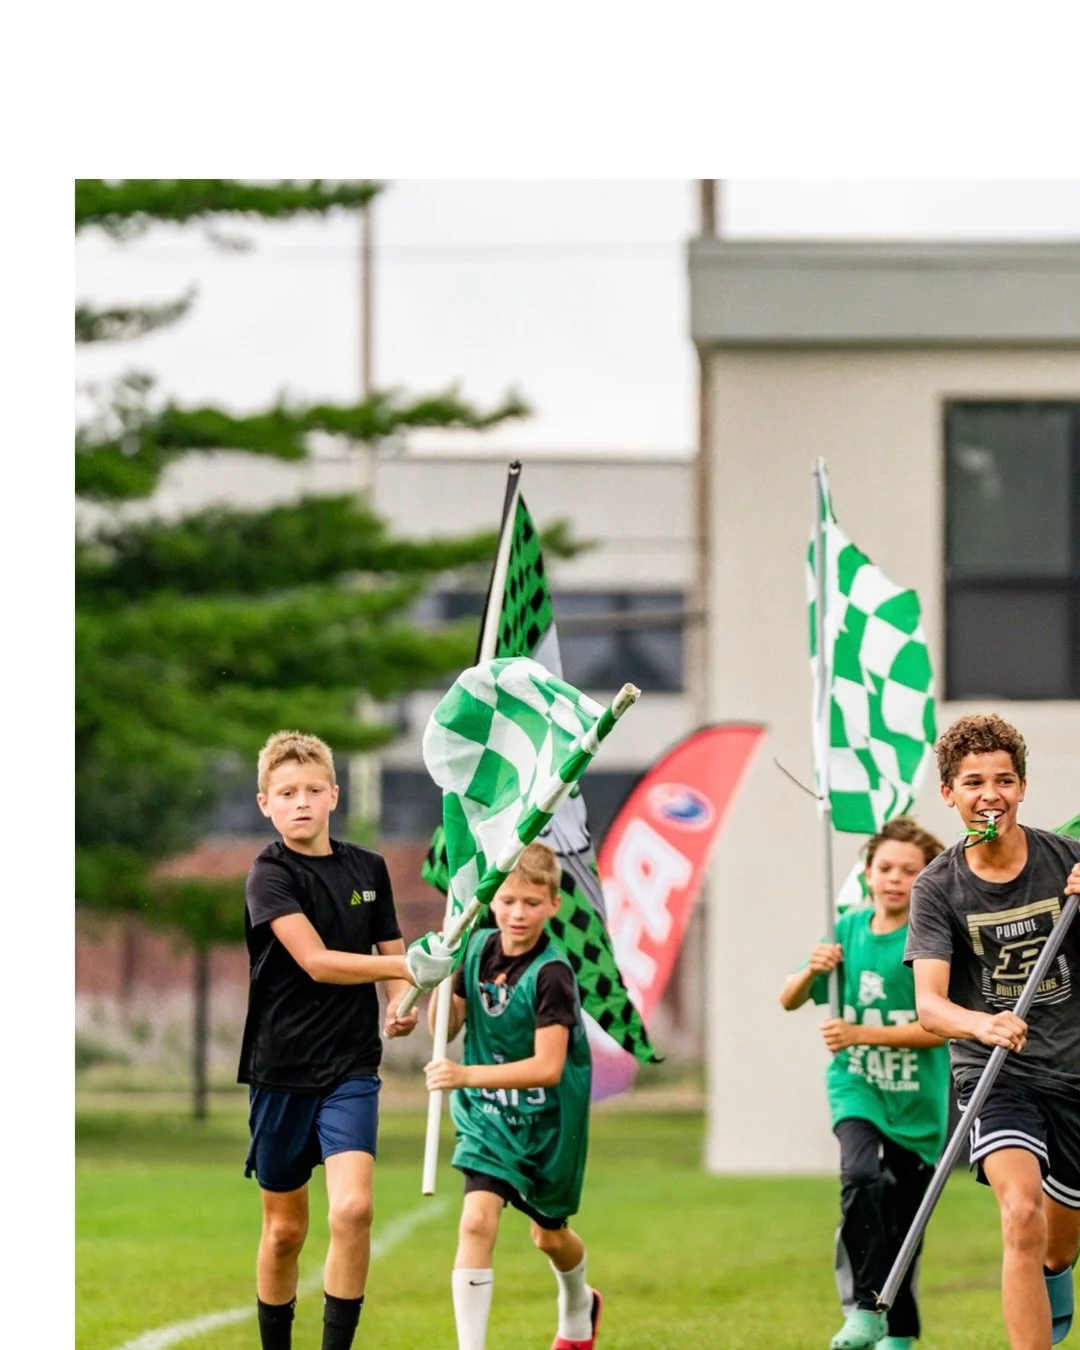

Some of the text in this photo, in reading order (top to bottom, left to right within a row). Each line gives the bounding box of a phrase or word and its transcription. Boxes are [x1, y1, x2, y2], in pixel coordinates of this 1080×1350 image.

[603, 816, 693, 1012] FA
[995, 918, 1039, 939] PURDUE
[996, 977, 1057, 997] BOILERKERS
